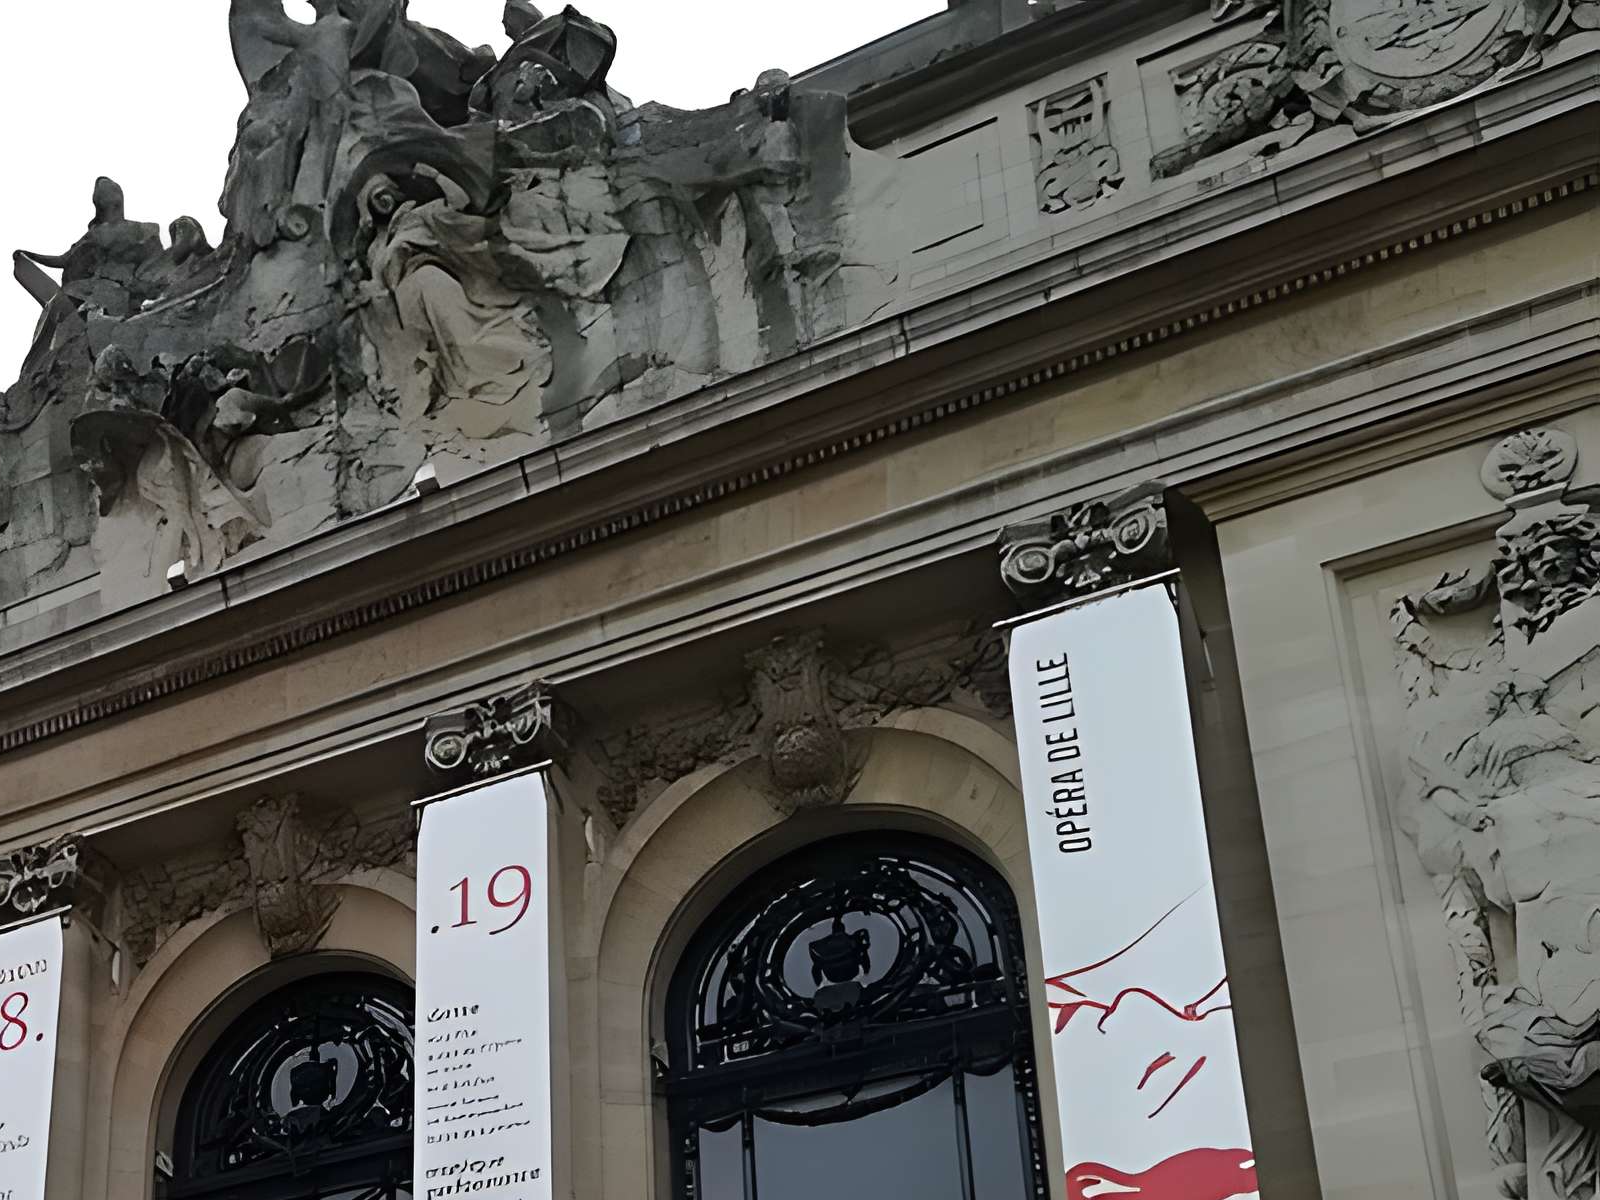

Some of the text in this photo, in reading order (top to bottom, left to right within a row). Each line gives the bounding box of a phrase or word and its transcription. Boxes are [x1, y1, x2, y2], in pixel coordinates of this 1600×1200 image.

[1036, 652, 1092, 854] OPÉRA DE LILLE
